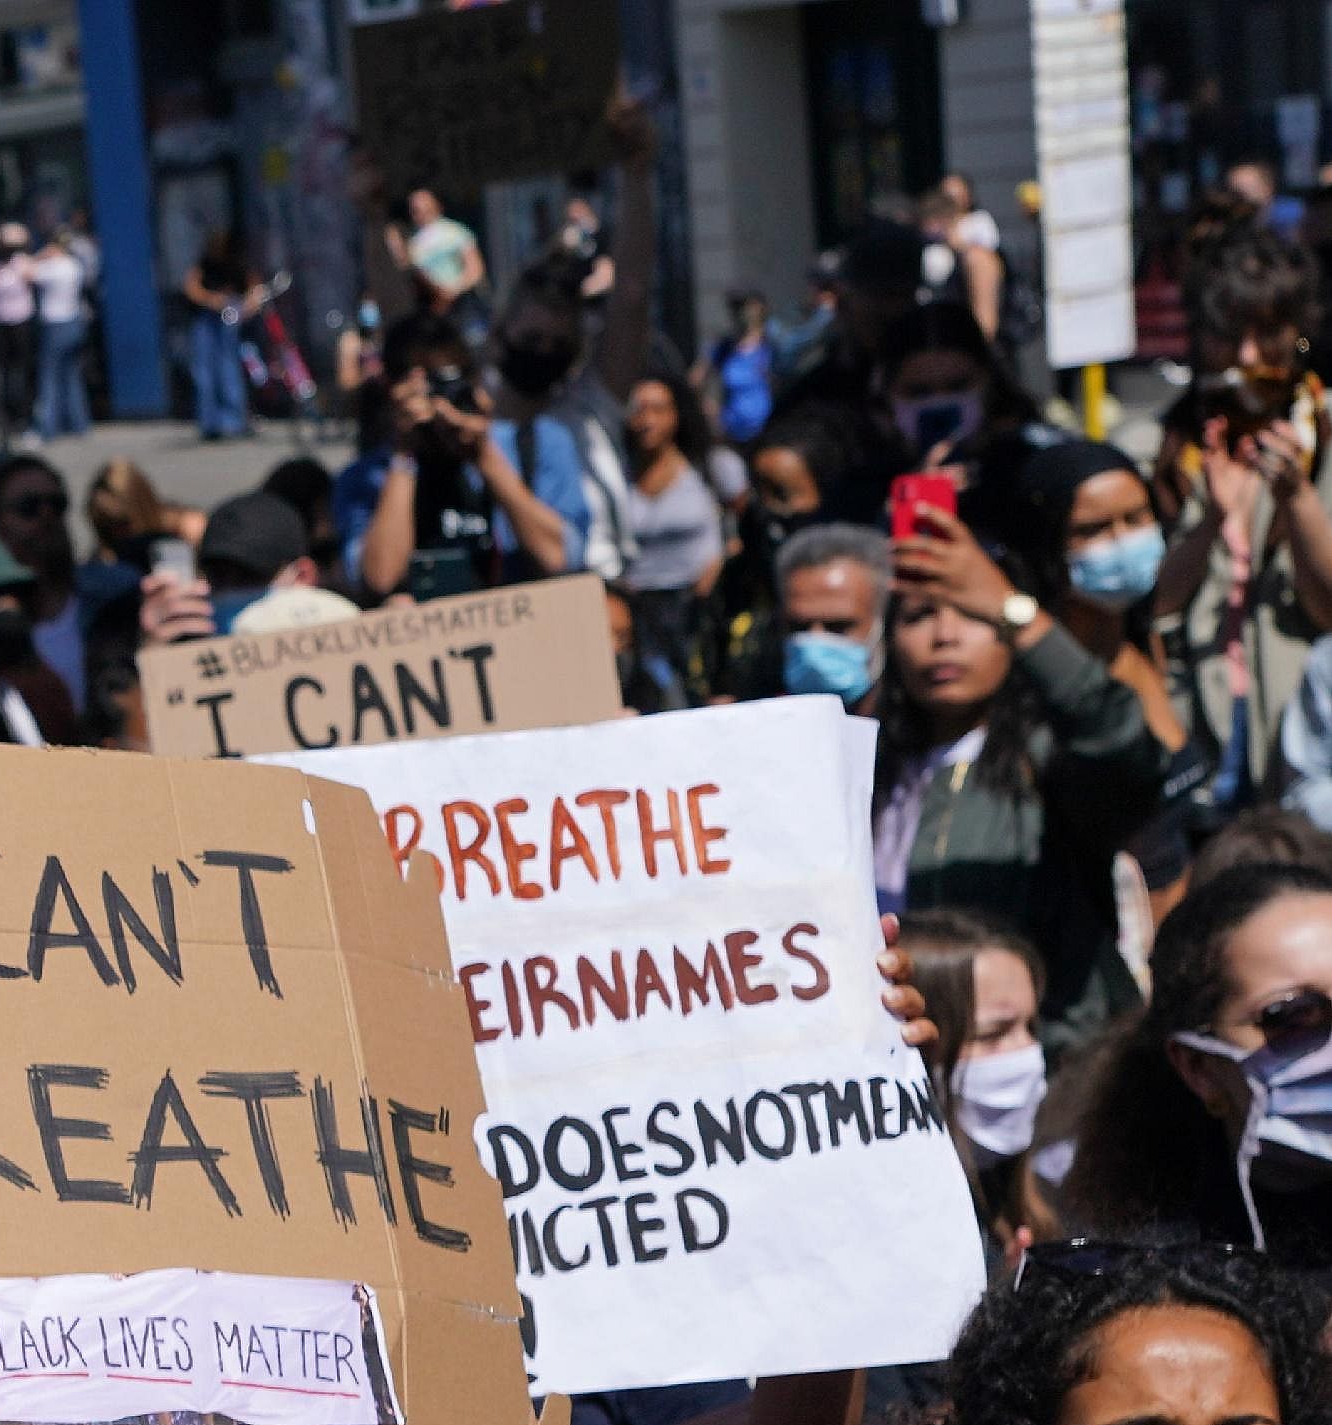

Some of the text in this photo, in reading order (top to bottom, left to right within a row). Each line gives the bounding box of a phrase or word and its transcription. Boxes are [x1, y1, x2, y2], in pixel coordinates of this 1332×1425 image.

[195, 592, 536, 681] #BLACKLIVESMATTER
[383, 782, 733, 902] BREATHE
[98, 1315, 195, 1373] LIVES
[213, 1319, 361, 1385] MATTER
